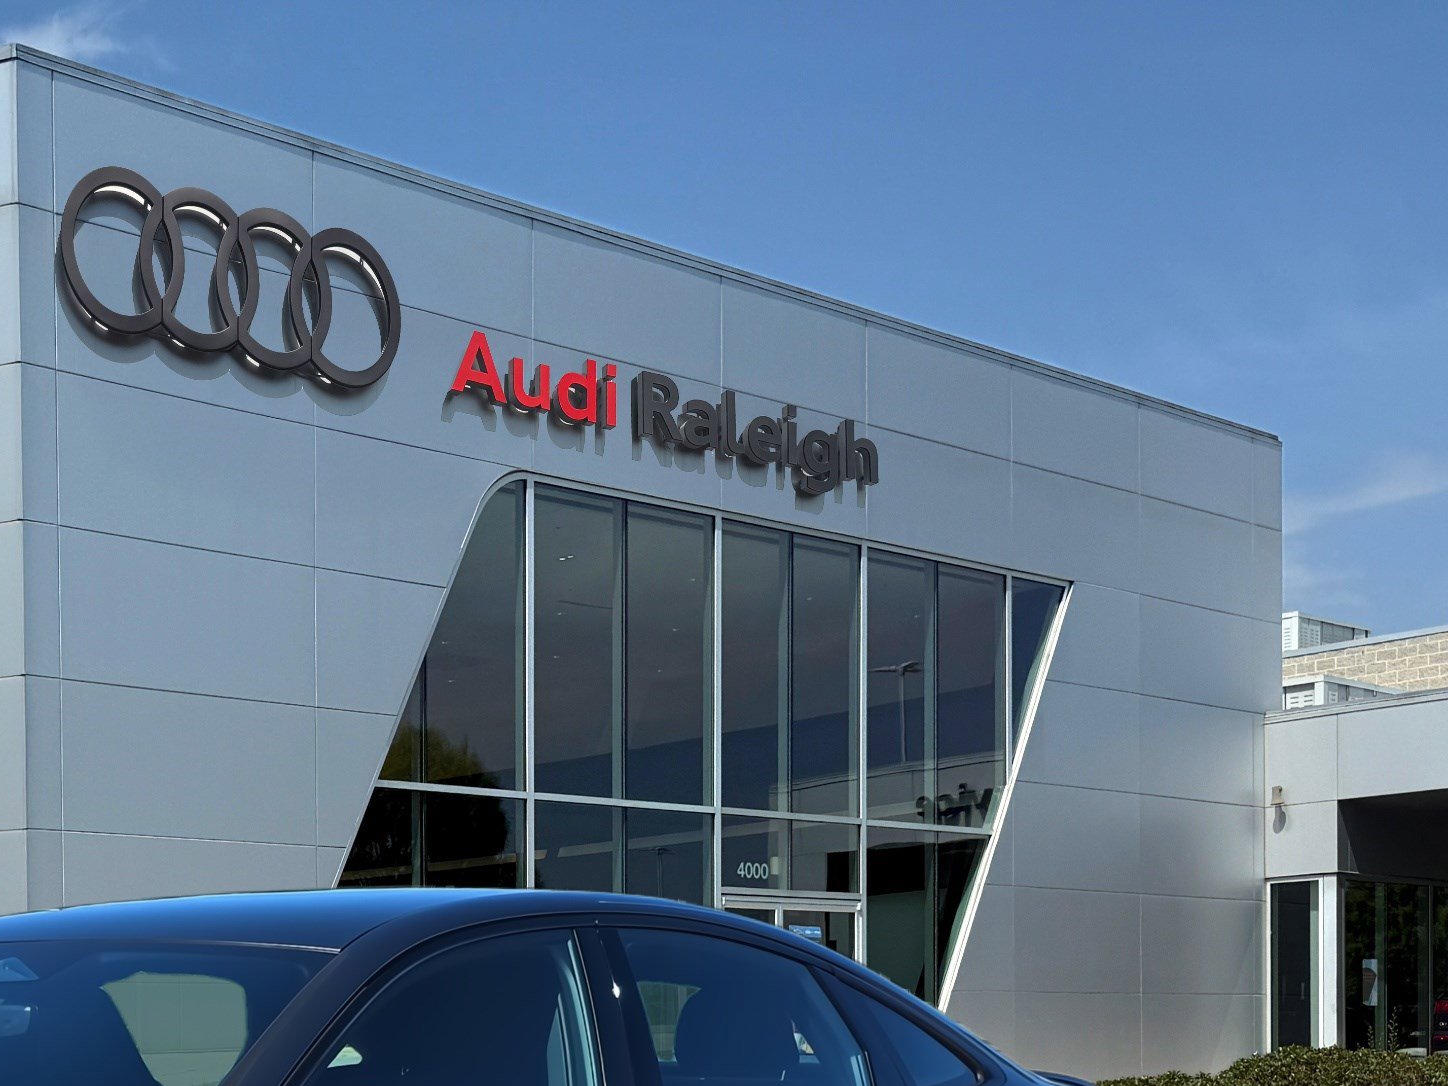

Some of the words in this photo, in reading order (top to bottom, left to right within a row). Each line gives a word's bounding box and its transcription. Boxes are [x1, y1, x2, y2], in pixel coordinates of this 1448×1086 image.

[450, 330, 617, 430] Audi
[632, 370, 879, 495] Raleigh
[736, 861, 769, 880] 4000
